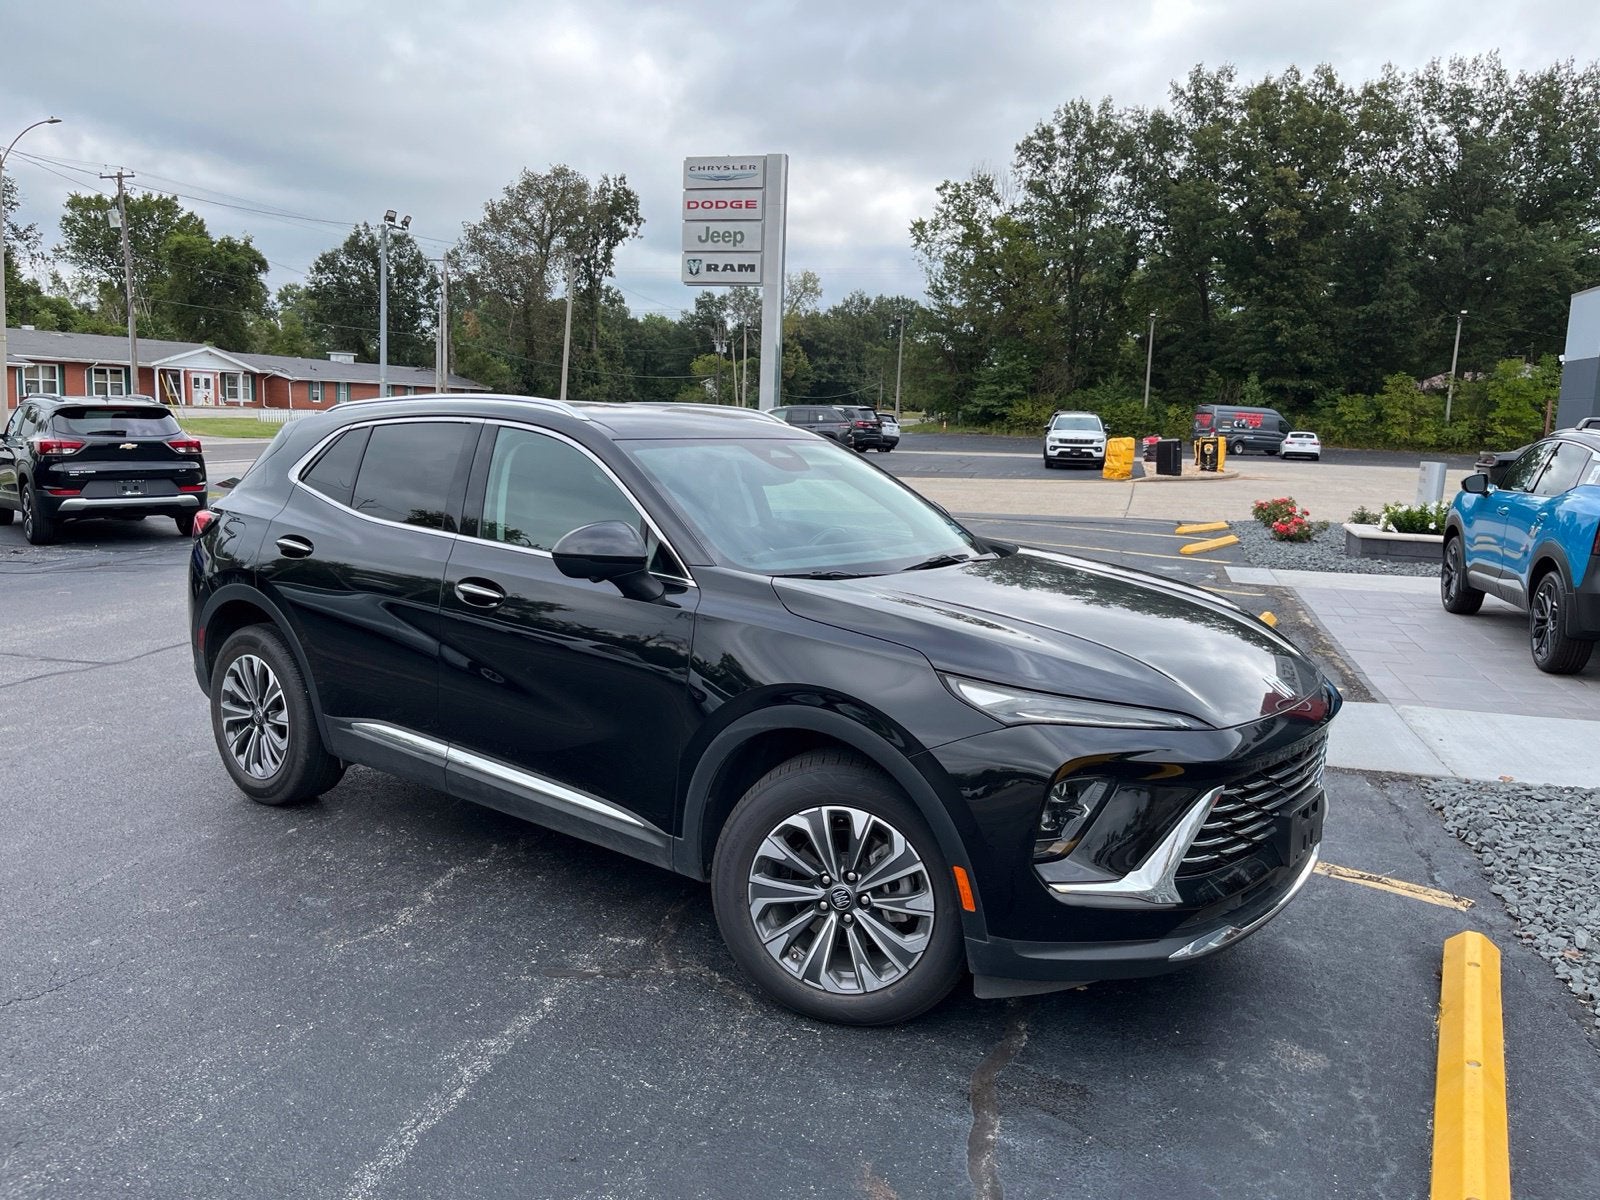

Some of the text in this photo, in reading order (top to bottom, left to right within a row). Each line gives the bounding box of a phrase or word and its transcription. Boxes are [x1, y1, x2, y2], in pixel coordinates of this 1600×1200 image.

[689, 164, 757, 172] CHRYSLER
[687, 200, 757, 210] DODGE
[697, 226, 745, 247] Jeep
[706, 263, 756, 273] RAM
